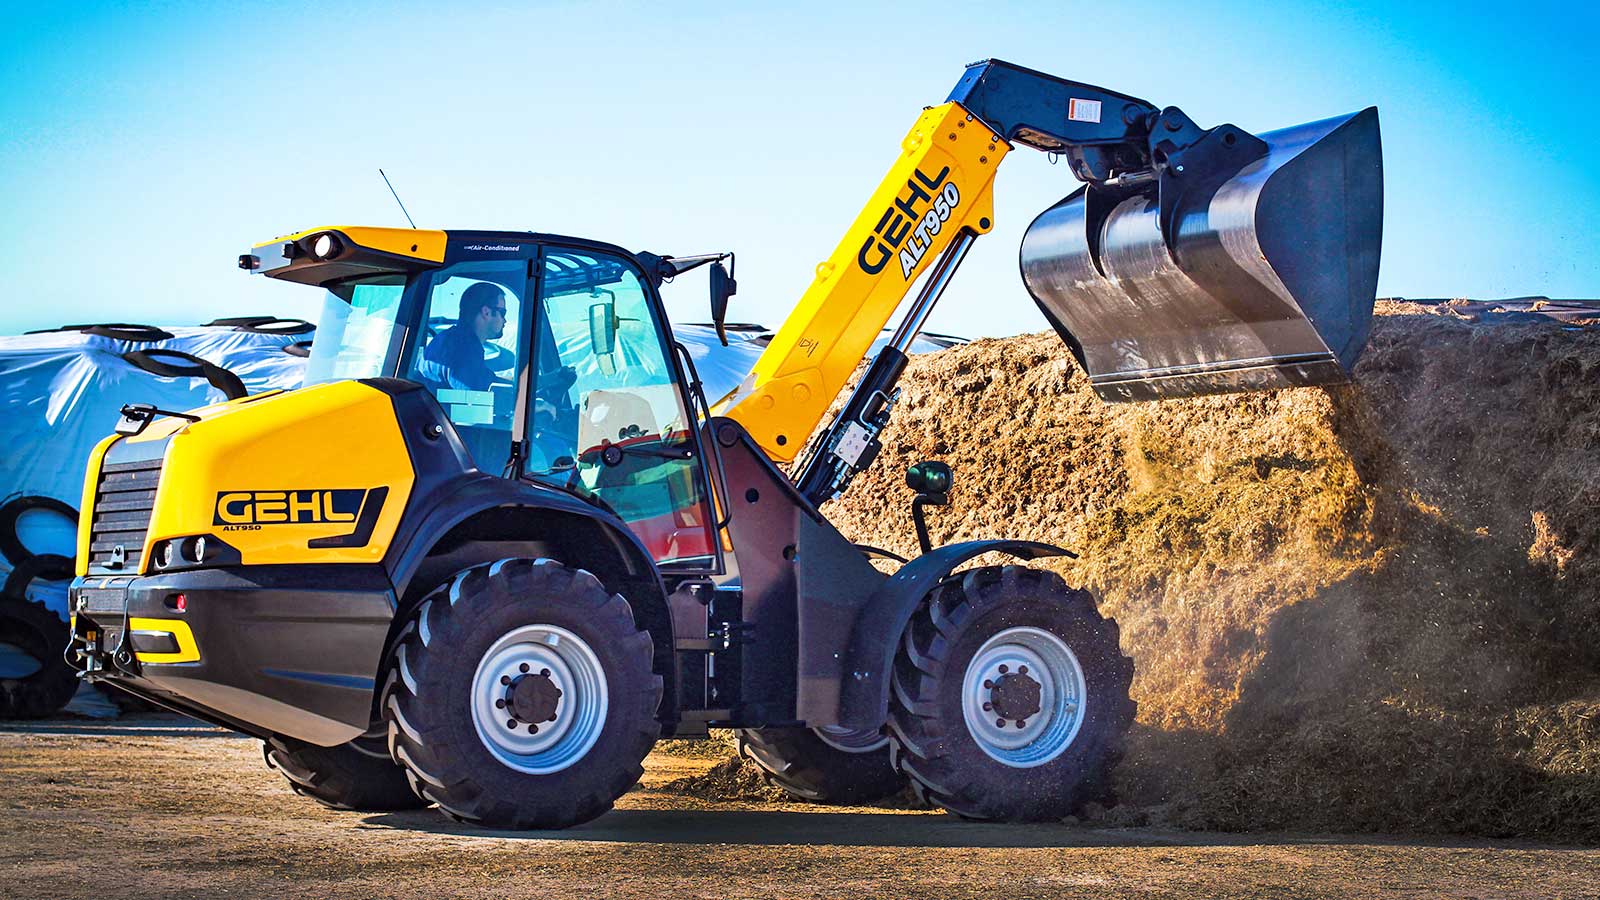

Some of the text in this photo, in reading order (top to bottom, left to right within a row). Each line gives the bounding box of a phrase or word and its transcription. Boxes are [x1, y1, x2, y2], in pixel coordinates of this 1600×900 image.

[858, 166, 950, 275] GEHL
[898, 181, 960, 281] ALT950
[217, 491, 355, 523] GEHL
